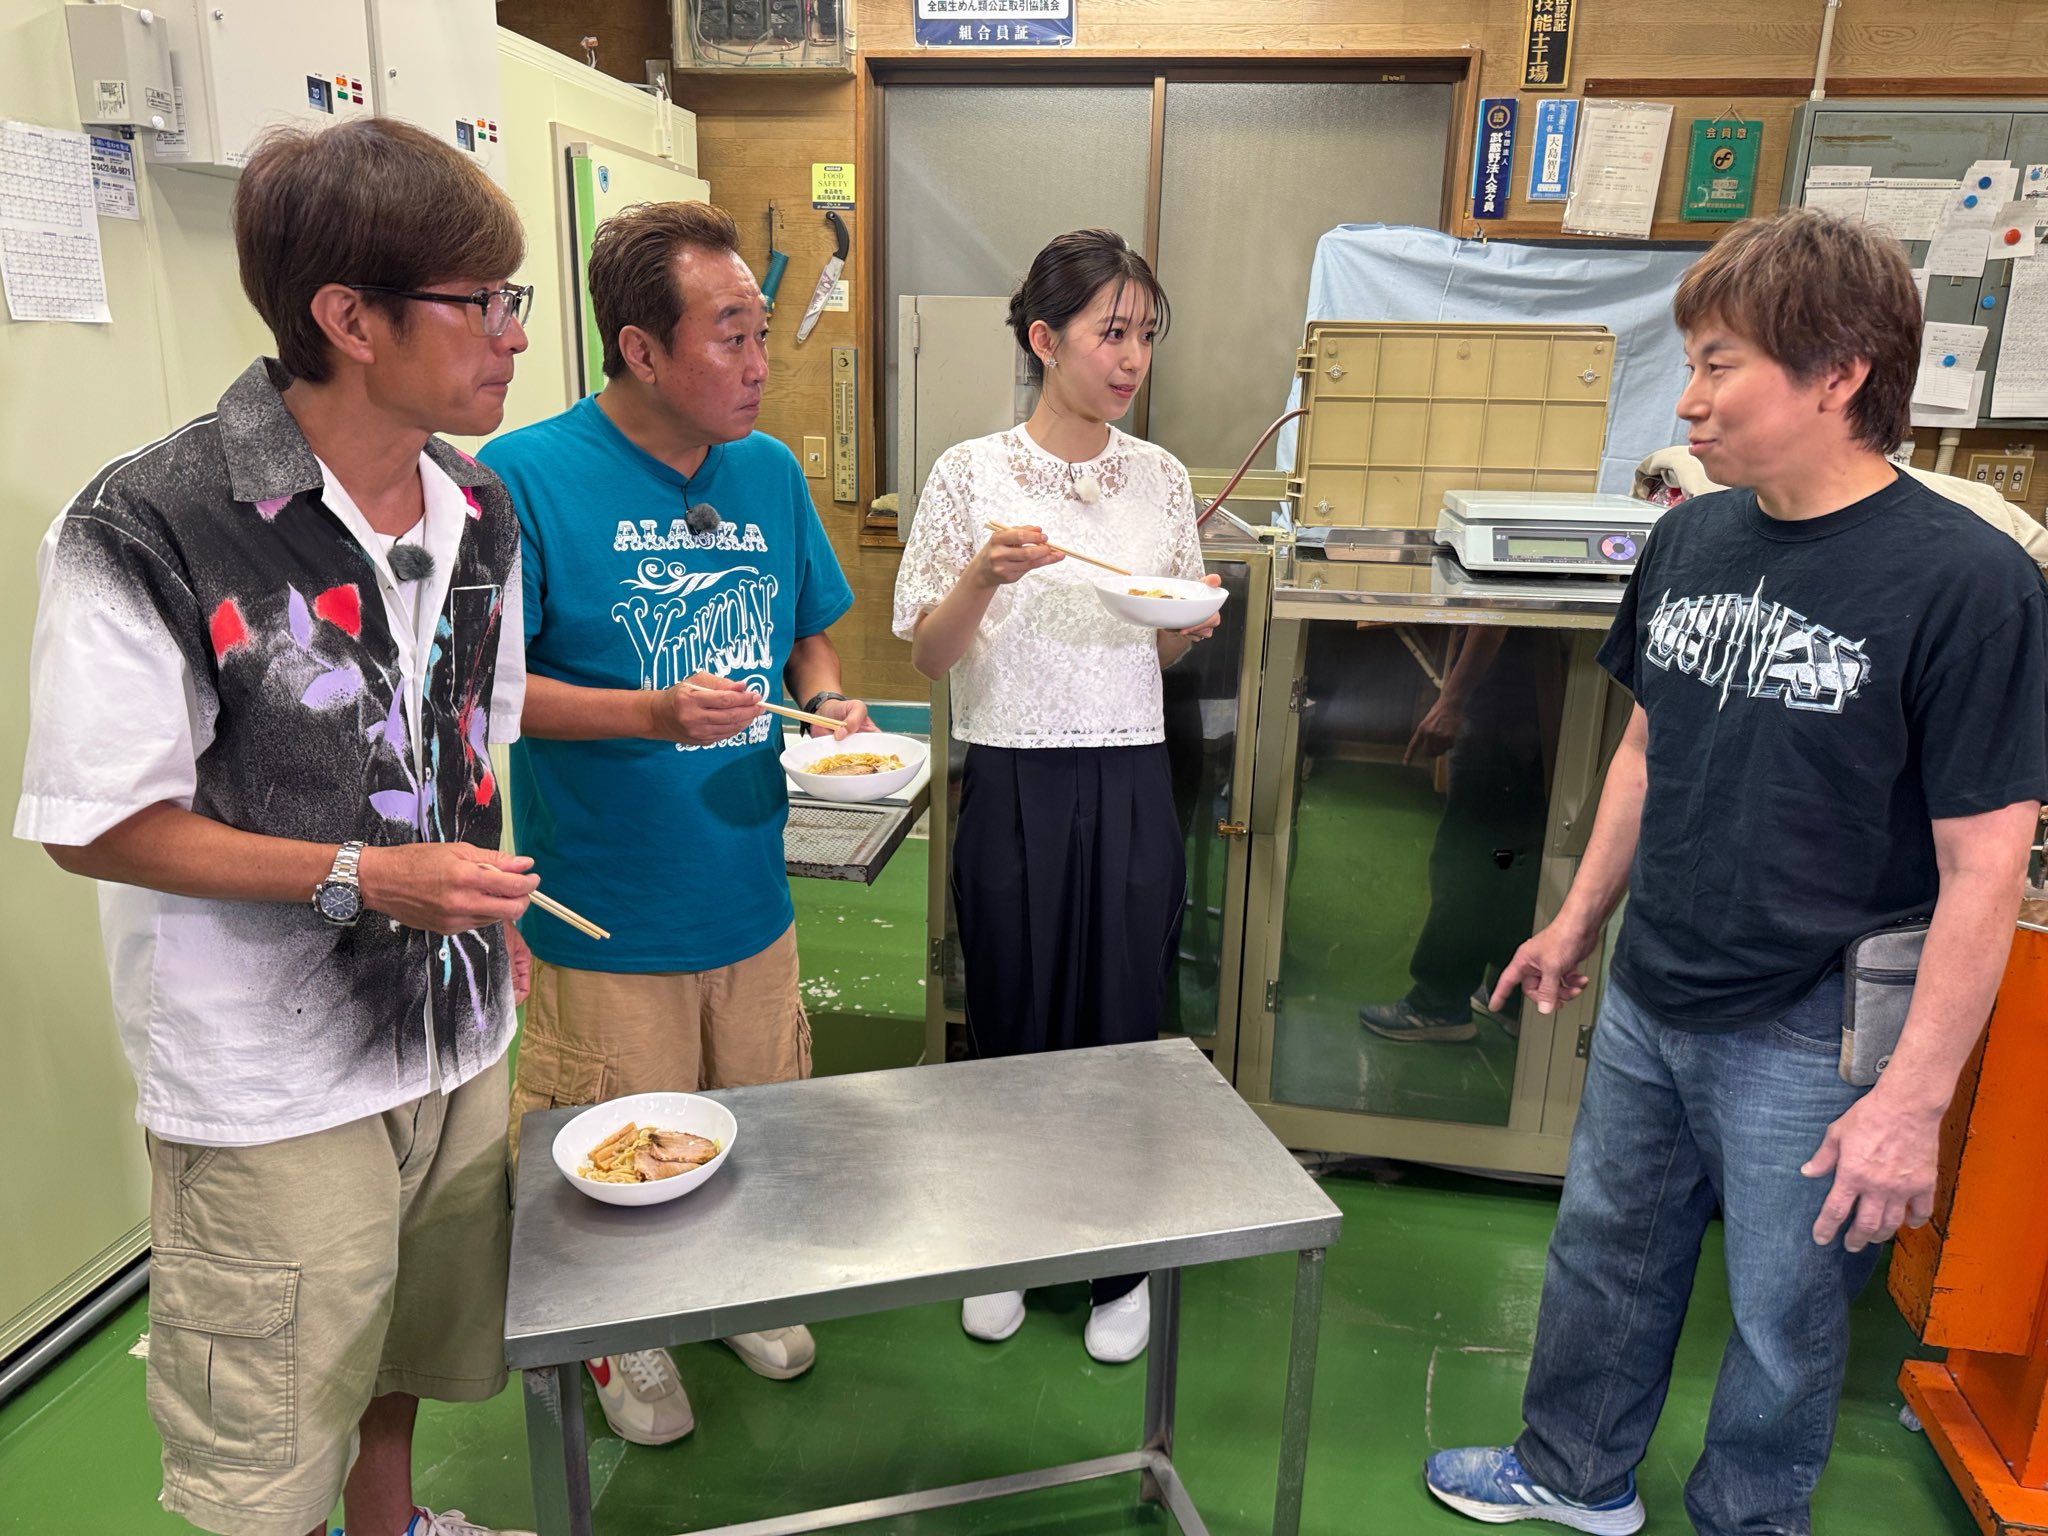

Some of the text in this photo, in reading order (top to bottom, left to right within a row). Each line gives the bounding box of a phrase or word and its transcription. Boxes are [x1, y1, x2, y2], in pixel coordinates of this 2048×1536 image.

[958, 24, 1029, 41] 組合員証
[1546, 103, 1556, 133] 責任者
[1705, 127, 1748, 139] 会員章
[1501, 130, 1512, 166] 社団法人
[818, 180, 848, 188] SAFETY
[1482, 132, 1504, 213] 武蔵野法人会々員
[611, 574, 778, 692] YUKON
